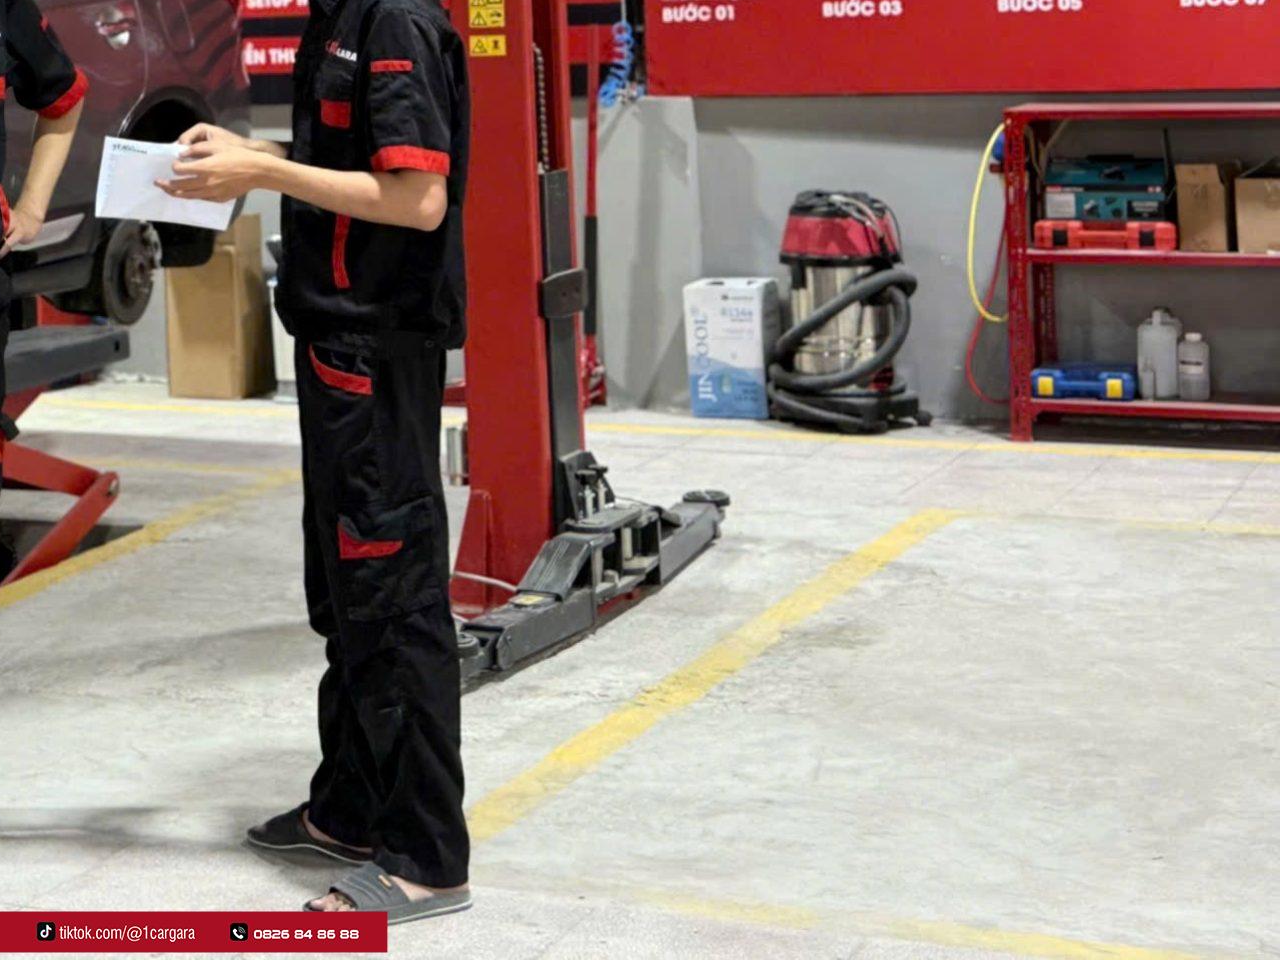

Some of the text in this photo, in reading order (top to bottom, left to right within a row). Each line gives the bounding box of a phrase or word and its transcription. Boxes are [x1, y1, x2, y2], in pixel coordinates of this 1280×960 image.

[662, 2, 735, 22] BƯỚC 01
[879, 0, 903, 16] 03
